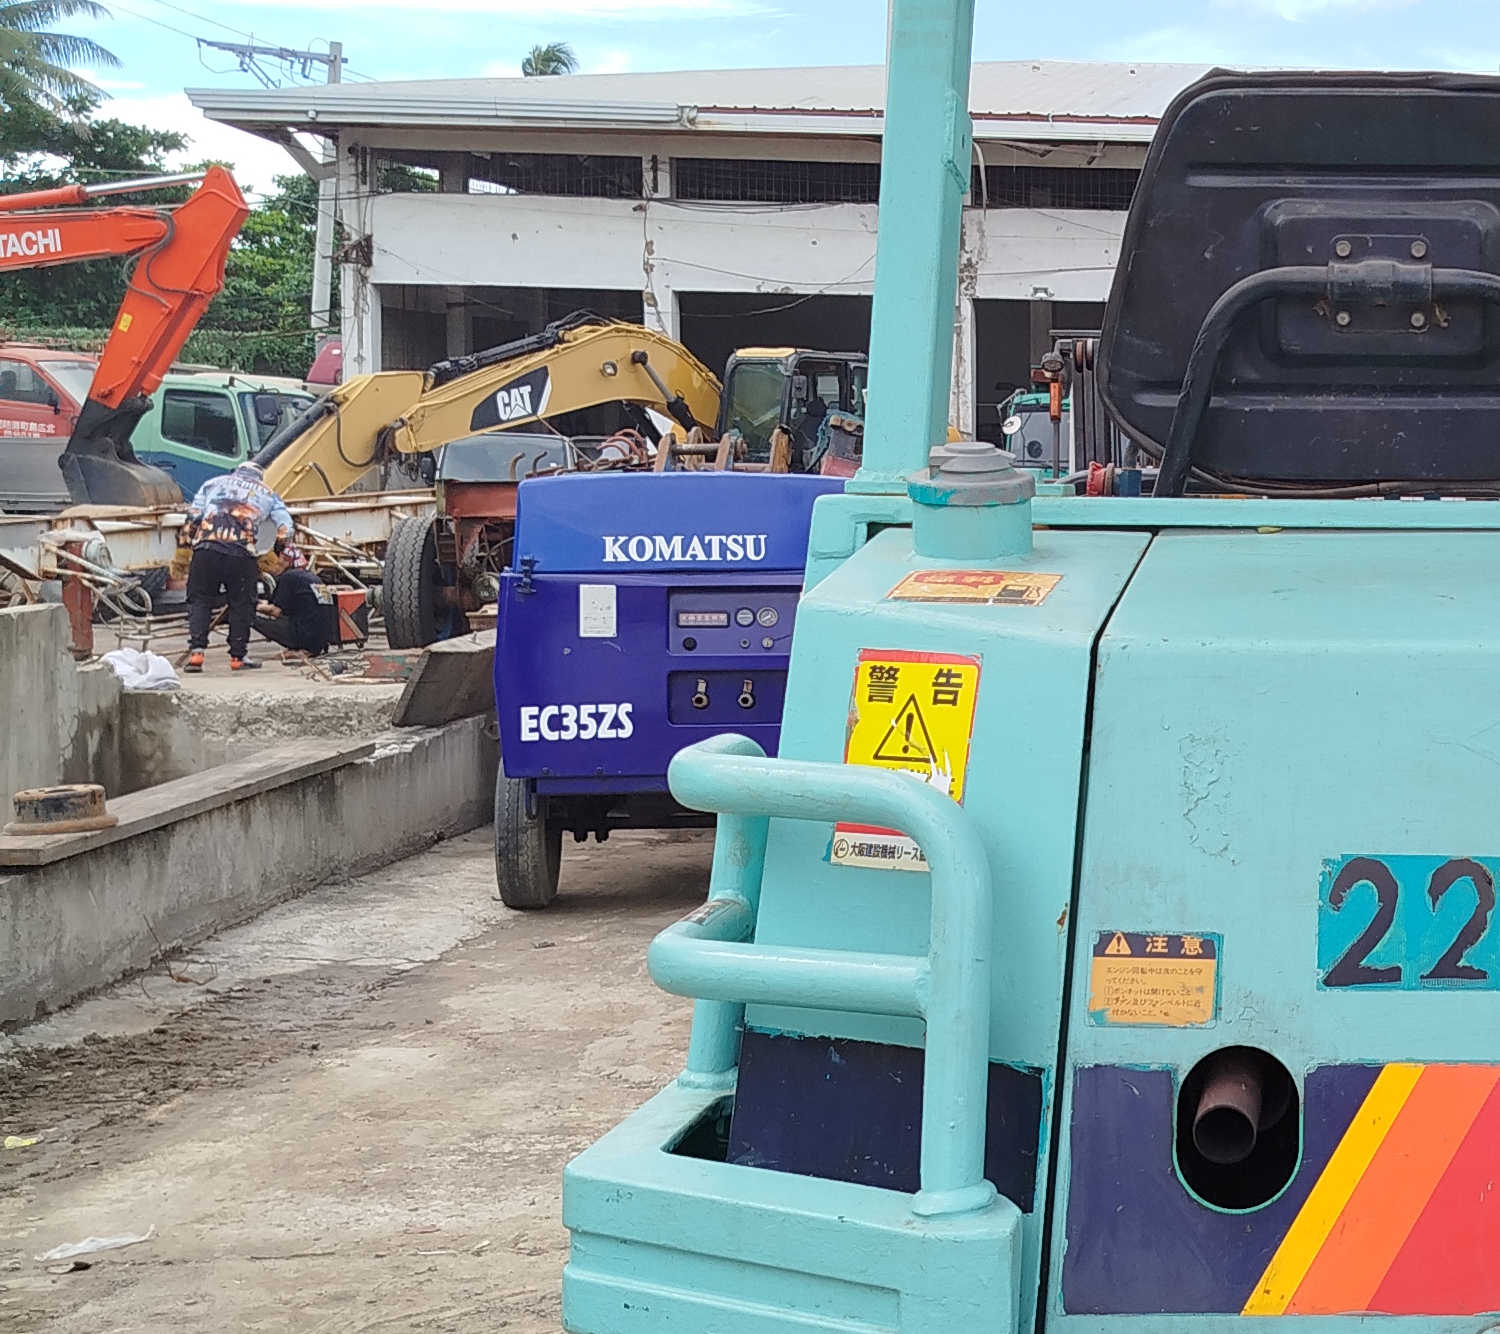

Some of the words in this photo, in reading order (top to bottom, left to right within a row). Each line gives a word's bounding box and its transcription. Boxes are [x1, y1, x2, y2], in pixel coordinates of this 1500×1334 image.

[496, 384, 533, 421] CAT
[602, 535, 768, 563] KOMATSU
[867, 664, 963, 707] 警告
[519, 701, 635, 743] EC35ZS
[1145, 934, 1204, 956] 注意
